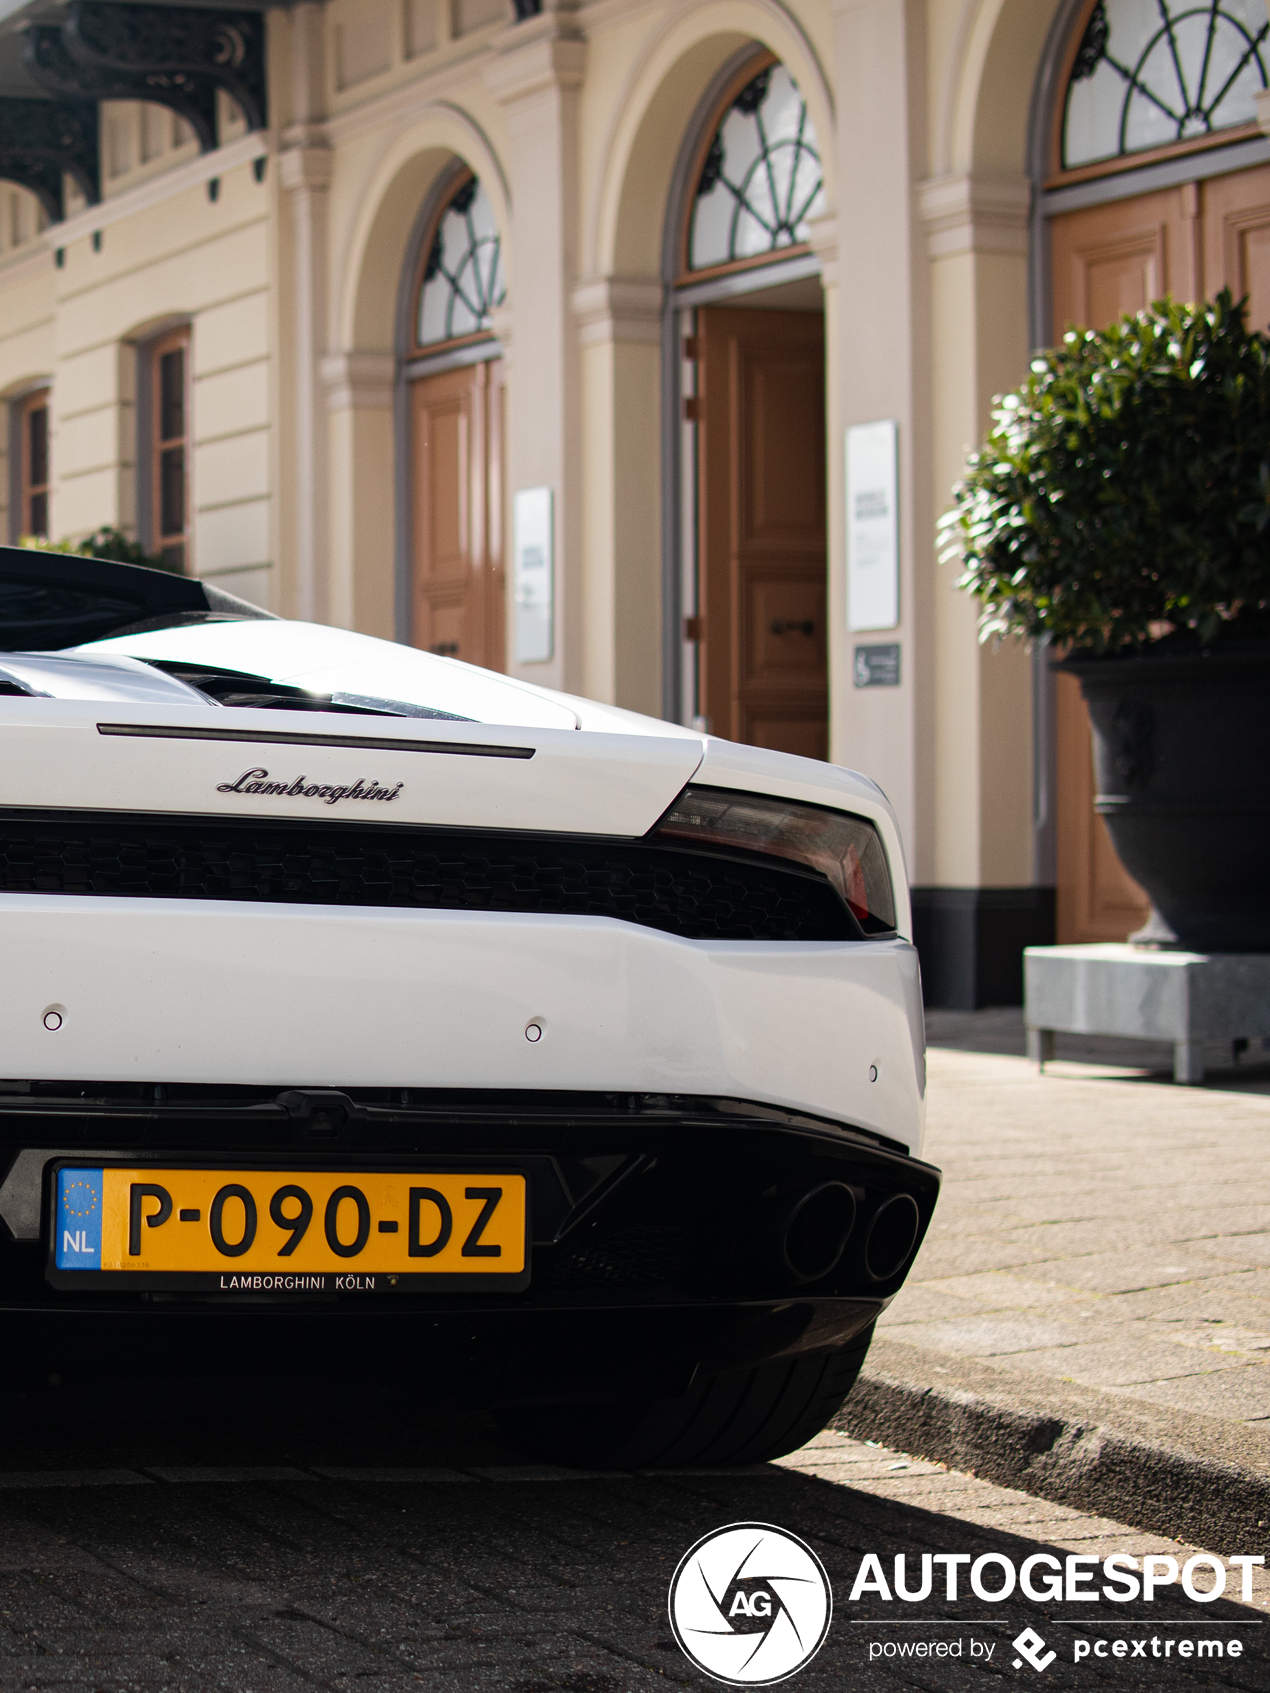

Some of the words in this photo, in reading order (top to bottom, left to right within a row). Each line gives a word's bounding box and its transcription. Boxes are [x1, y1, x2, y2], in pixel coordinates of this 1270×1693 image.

[215, 766, 404, 805] Lamborghini
[127, 1183, 503, 1258] P-090-DZ
[63, 1230, 94, 1253] NL
[220, 1275, 326, 1290] LAMBORGHINI
[335, 1273, 376, 1290] KÖLN
